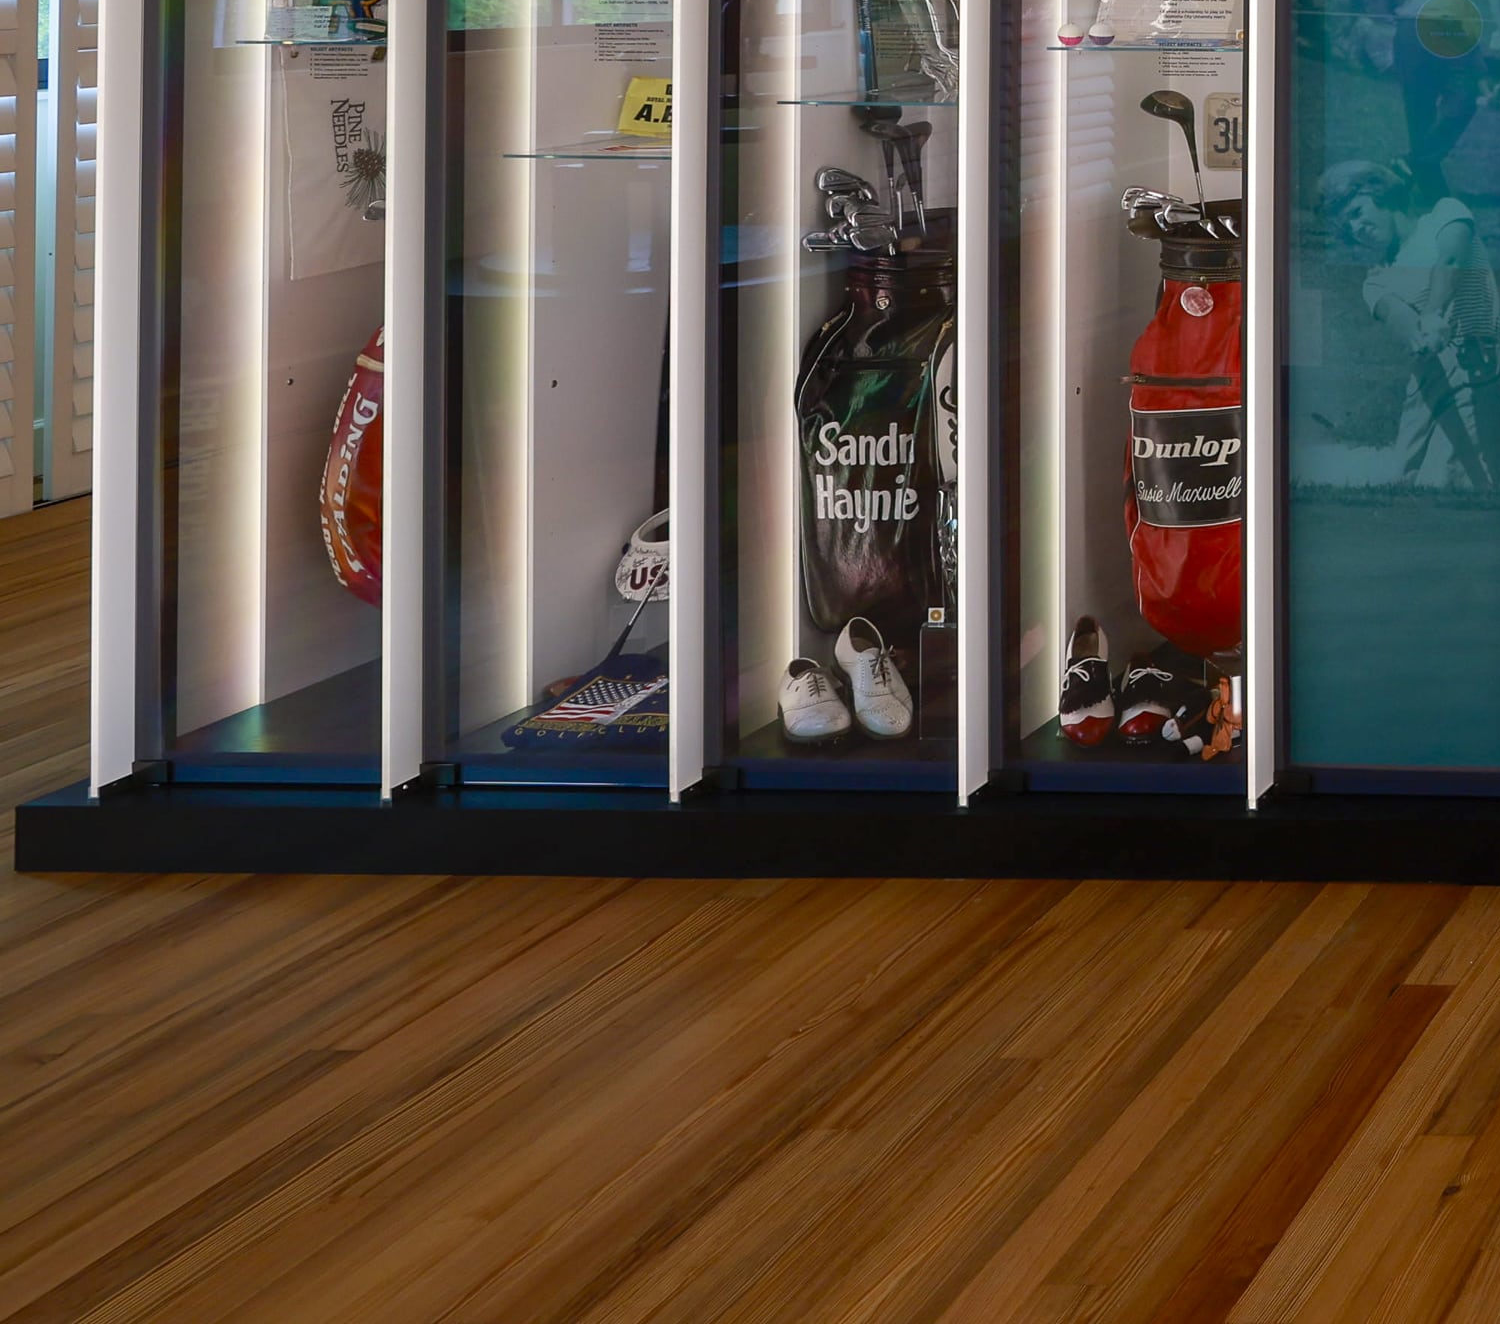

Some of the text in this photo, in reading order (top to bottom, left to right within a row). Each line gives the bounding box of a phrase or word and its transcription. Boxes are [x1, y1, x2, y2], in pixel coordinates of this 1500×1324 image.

[330, 98, 350, 173] NEEDLES
[348, 101, 366, 143] PINE
[1133, 435, 1241, 467] Dunlop
[815, 474, 920, 533] Haynie
[1137, 475, 1242, 503] Susie Maxwell
